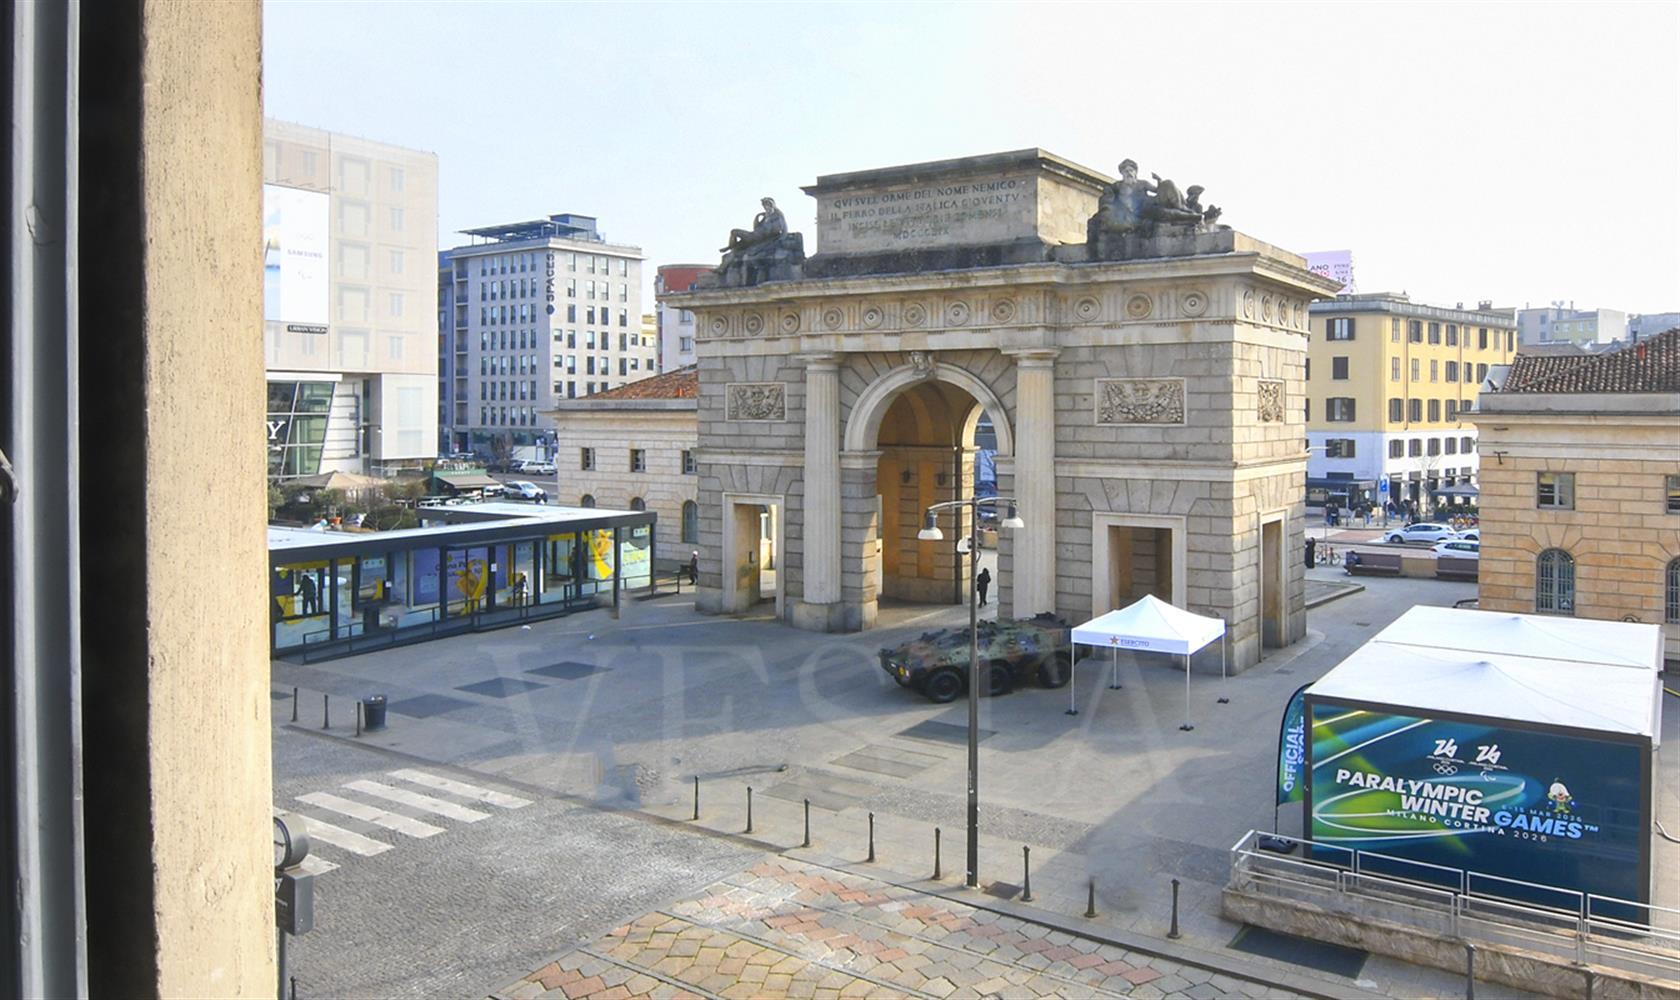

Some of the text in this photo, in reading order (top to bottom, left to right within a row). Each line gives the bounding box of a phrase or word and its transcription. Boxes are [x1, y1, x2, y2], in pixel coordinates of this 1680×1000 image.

[937, 185, 968, 197] NOME
[972, 180, 1016, 193] NEMICO
[878, 205, 911, 216] DELLA
[287, 249, 323, 258] SAMSUNG
[1283, 727, 1299, 792] OFFICIAL
[1336, 769, 1484, 805] PARALYMPIC
[1401, 795, 1490, 823] WINTER
[1530, 809, 1551, 817] MAR
[1386, 809, 1547, 842] MILANO CORTINA 2026
